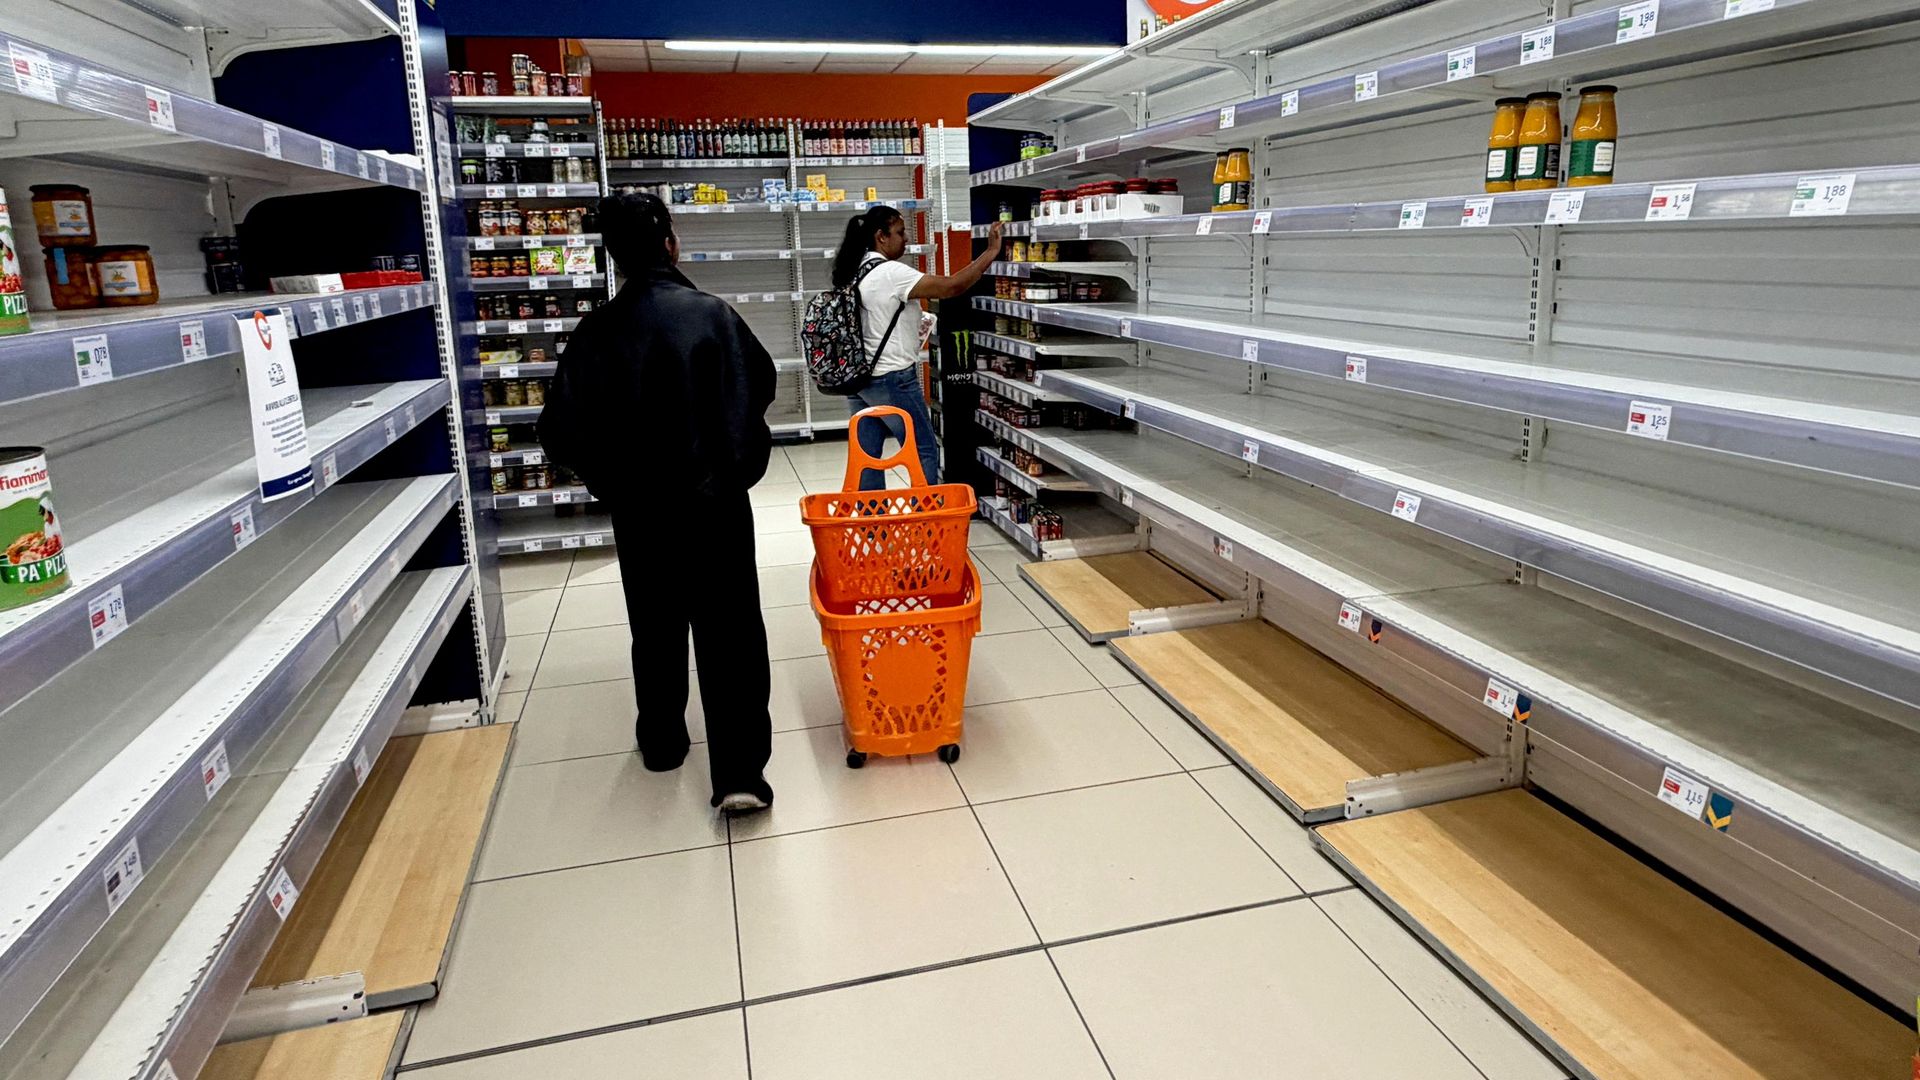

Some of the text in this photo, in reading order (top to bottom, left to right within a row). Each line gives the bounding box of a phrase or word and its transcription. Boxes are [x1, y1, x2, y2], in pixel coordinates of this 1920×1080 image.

[1638, 10, 1655, 28] 1,98
[1823, 185, 1846, 202] 1,88
[1566, 200, 1581, 214] 1,10
[1651, 414, 1667, 430] 1,25
[1685, 788, 1704, 806] 1,15
